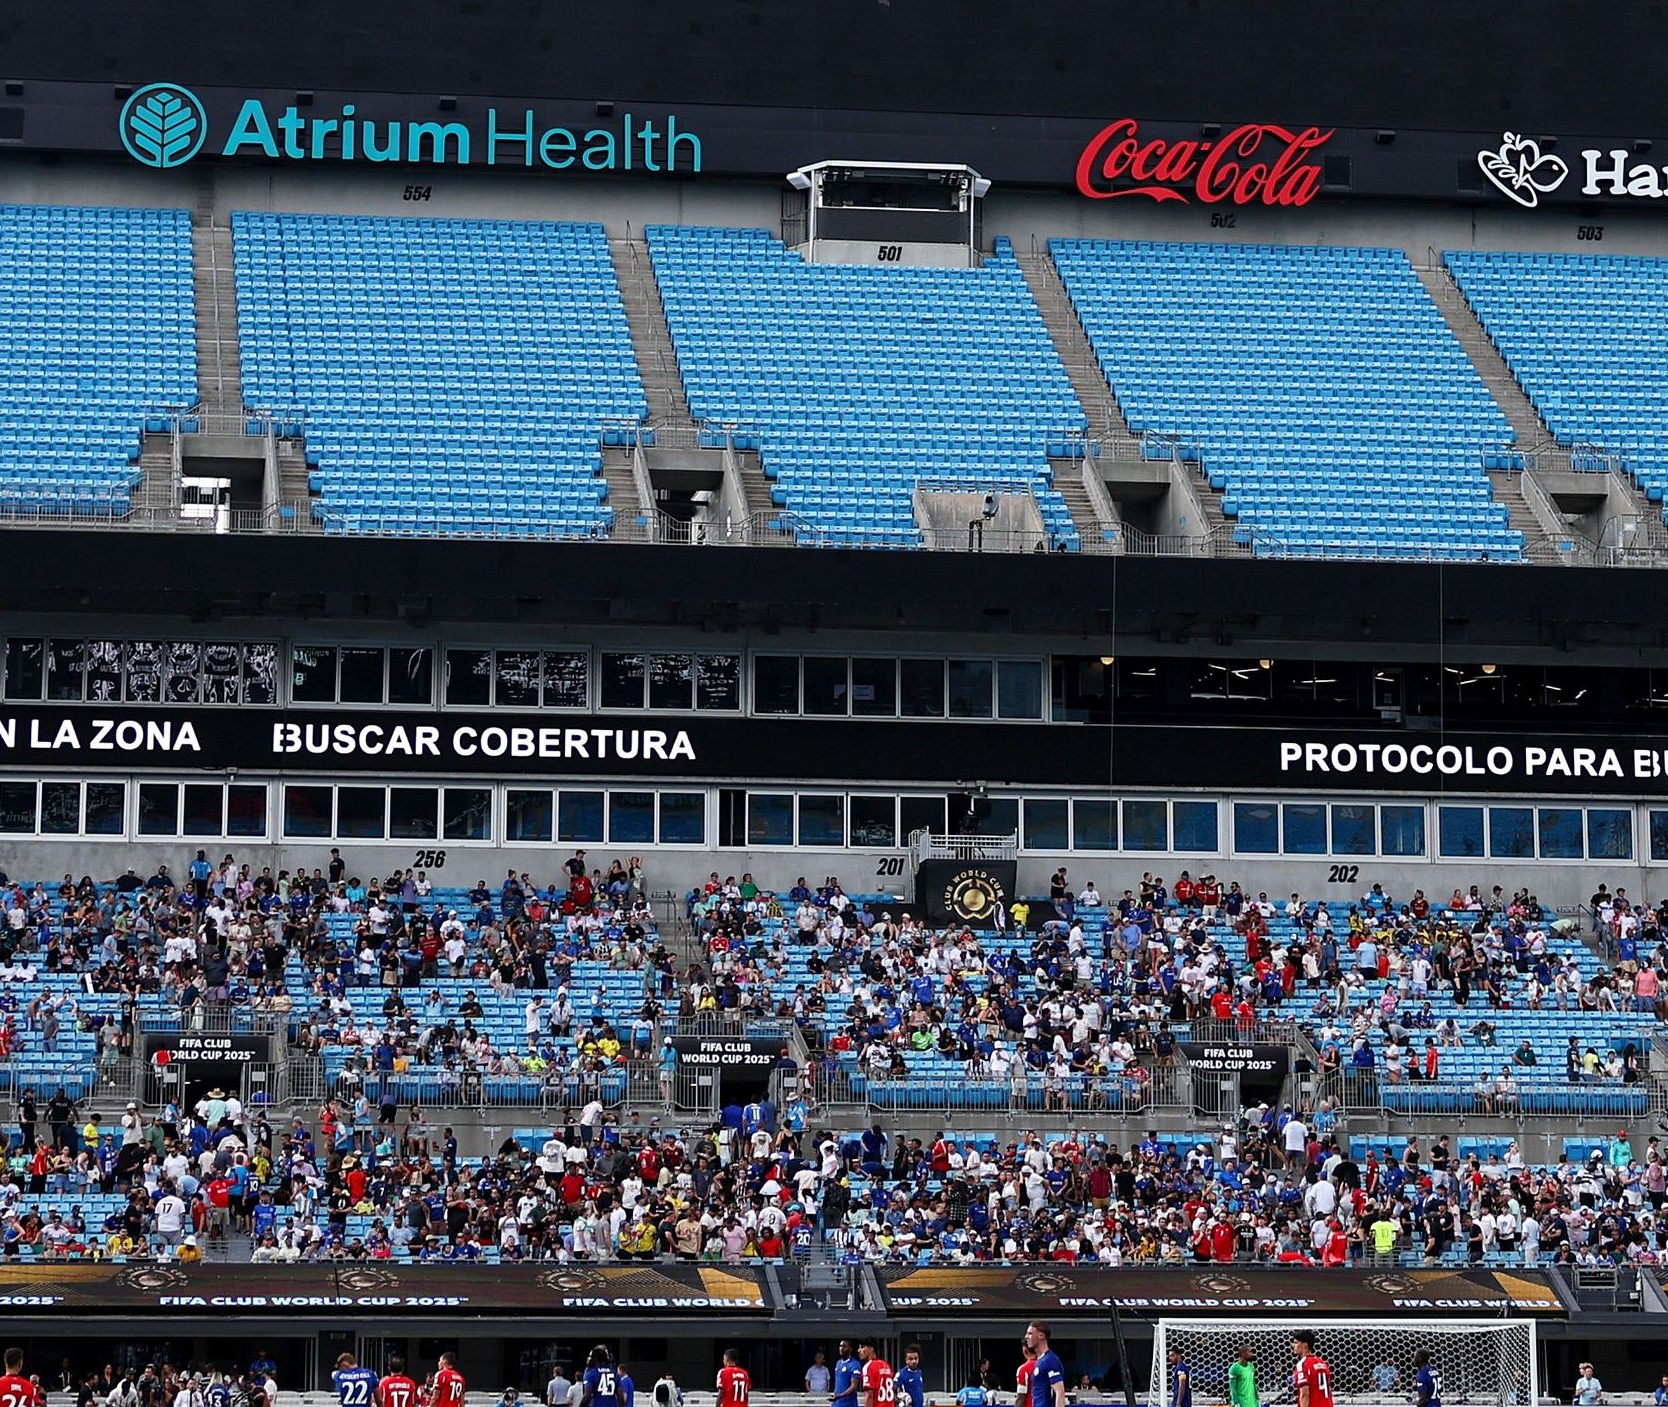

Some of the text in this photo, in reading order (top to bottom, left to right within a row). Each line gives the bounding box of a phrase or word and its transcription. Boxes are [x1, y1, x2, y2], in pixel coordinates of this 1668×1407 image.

[222, 99, 702, 172] Atrium Health
[1075, 118, 1336, 207] Coca-Cola
[403, 185, 433, 202] 554
[1210, 212, 1236, 230] 502
[1577, 224, 1604, 242] 503
[877, 244, 902, 262] 501
[30, 719, 81, 749] LA
[89, 719, 201, 751] ZONA
[272, 723, 696, 760] BUSCAR COBERTURA
[1280, 742, 1513, 775] PROTOCOLO
[1525, 747, 1625, 777] PARA
[413, 849, 447, 869] 256
[876, 858, 905, 876] 201
[952, 870, 987, 884] WORLD
[1327, 864, 1360, 883] 202
[179, 1038, 232, 1048] FIFA CLUB
[700, 1042, 752, 1052] FIFA CLUB
[200, 1050, 223, 1060] CUP
[681, 1054, 743, 1064] WORLD CUP
[1204, 1048, 1254, 1058] FIFA CLUB
[1224, 1060, 1244, 1069] CUP
[163, 1203, 173, 1213] 17
[797, 1234, 810, 1245] 20
[160, 1297, 401, 1306] FIFA CLUB WORLD CUP
[562, 1298, 610, 1307] FIFA
[613, 1298, 668, 1307] CLUB
[672, 1298, 751, 1307] WORLD
[1059, 1298, 1259, 1307] FIFA CLUB WORLD CUP
[1392, 1299, 1551, 1308] FIFA CLUB WORLD
[340, 1380, 368, 1405] 22
[596, 1373, 616, 1396] 45
[1317, 1372, 1329, 1399] 4
[391, 1391, 410, 1407] 17
